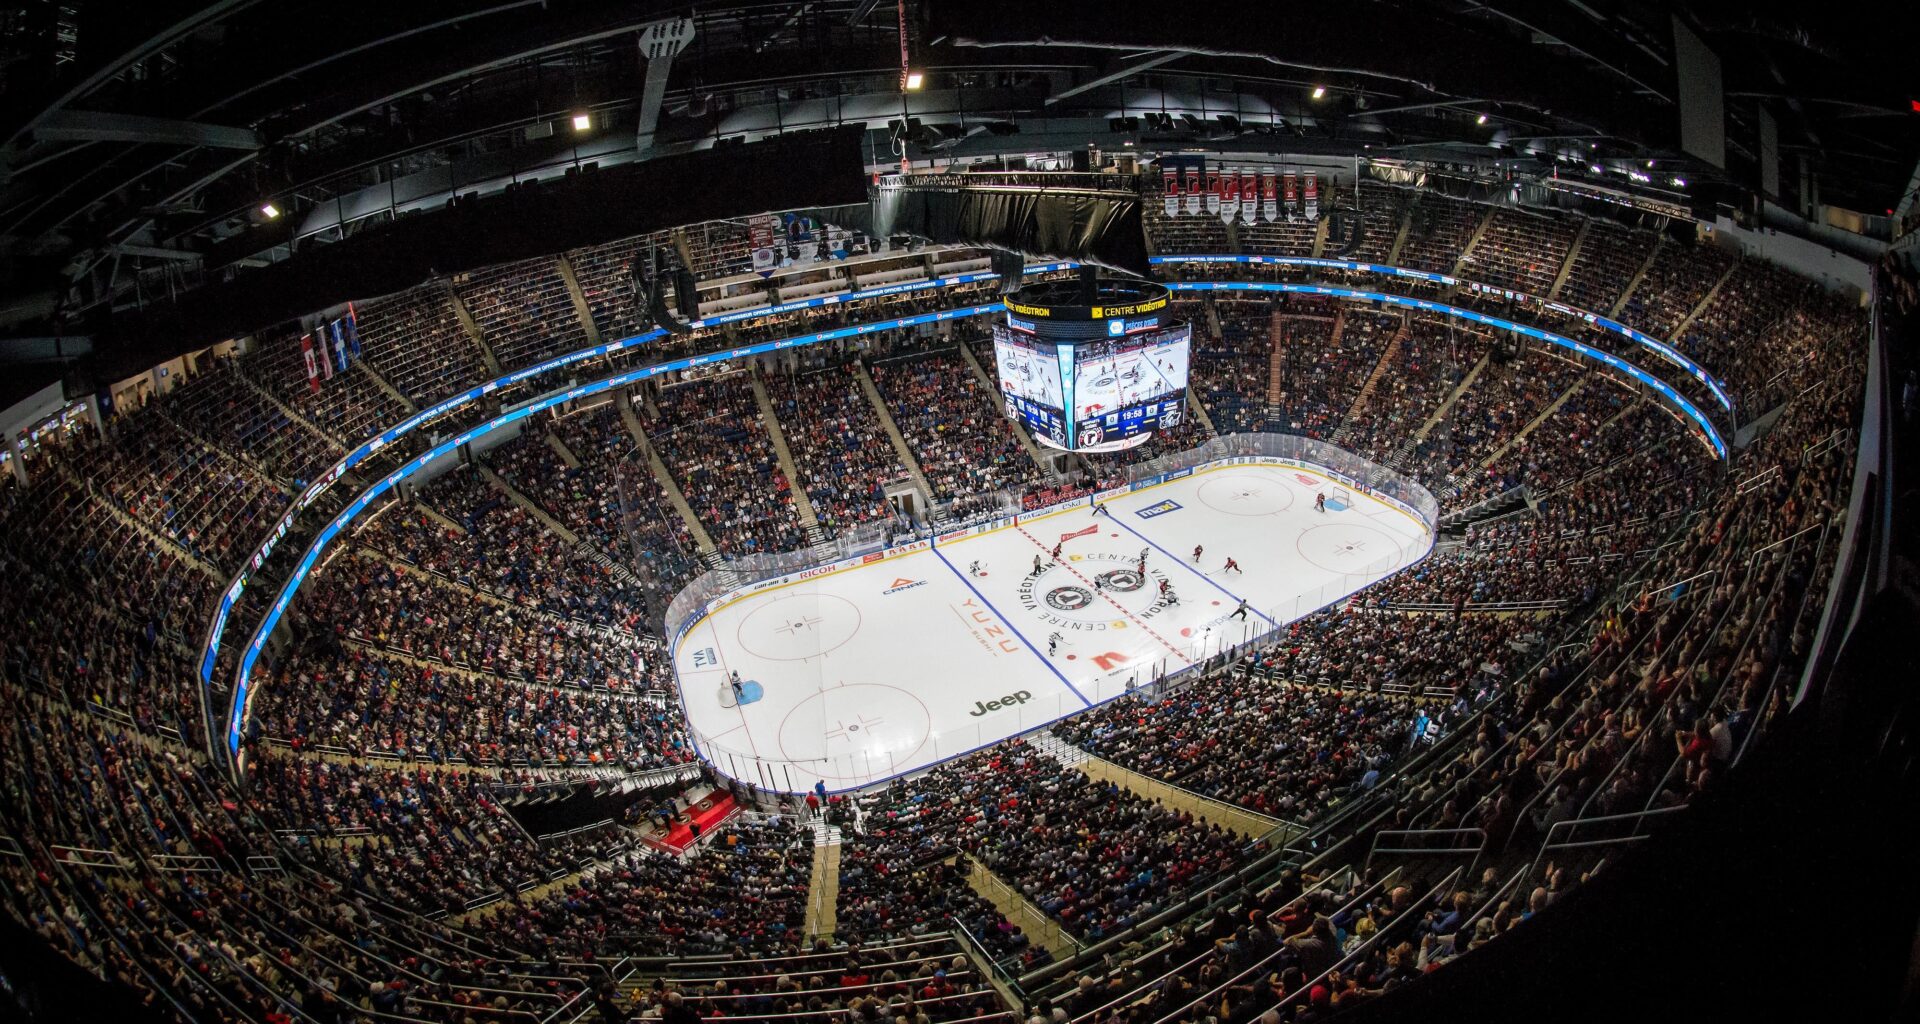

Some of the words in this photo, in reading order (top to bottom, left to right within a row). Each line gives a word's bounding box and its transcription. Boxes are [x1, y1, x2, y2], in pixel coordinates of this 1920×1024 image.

[1016, 304, 1050, 317] VIDÉOTRON
[1105, 306, 1134, 316] CENTRE
[1136, 299, 1166, 313] VIDÉOTRON
[510, 367, 541, 381] FOURNISSEUR
[542, 361, 560, 370] OFFICIEL
[939, 530, 968, 542] Qualinet
[1087, 553, 1140, 565] CENTR
[800, 564, 836, 579] RICOH
[754, 579, 779, 590] can-am
[883, 580, 928, 595] CANAC
[962, 599, 1020, 653] YUZU
[1038, 612, 1106, 630] CENTRE
[972, 630, 994, 652] SUSHI
[693, 650, 707, 668] TVA
[970, 690, 1032, 717] Jeep
